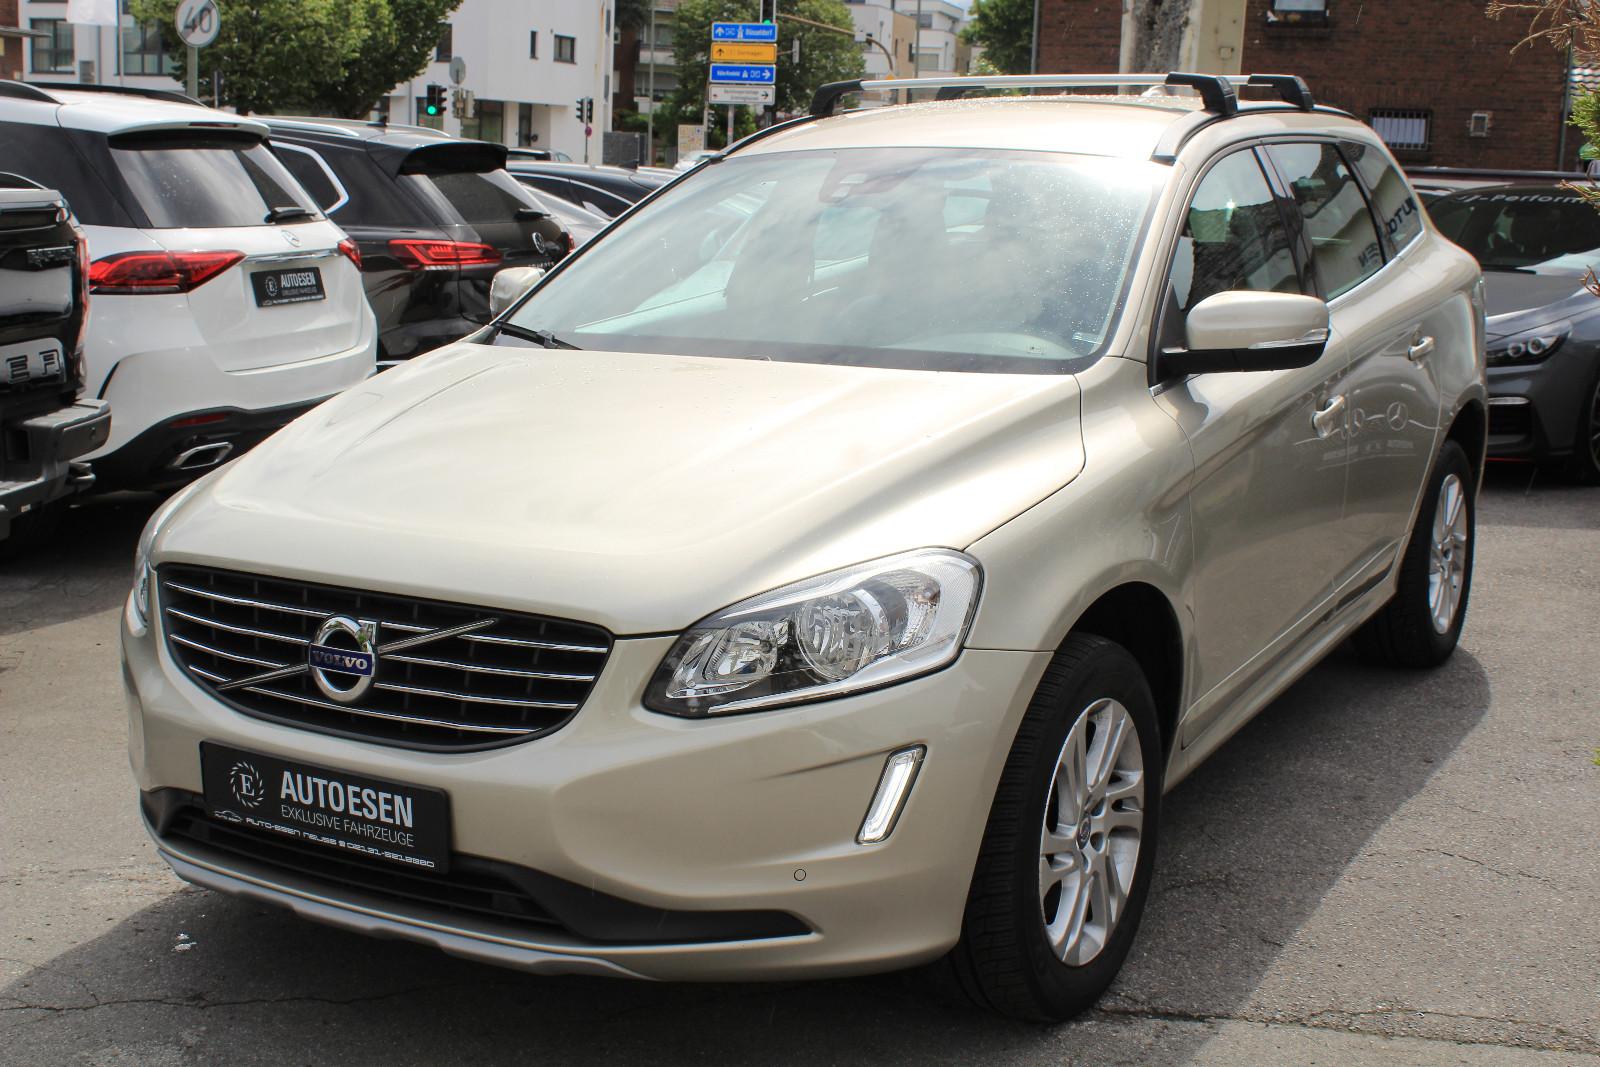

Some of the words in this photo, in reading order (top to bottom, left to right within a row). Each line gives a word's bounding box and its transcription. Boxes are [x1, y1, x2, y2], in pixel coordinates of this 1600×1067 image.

[183, 5, 212, 33] 40
[280, 272, 316, 288] AUTOESEN
[312, 650, 368, 670] VOLVO
[239, 773, 255, 797] E
[280, 770, 414, 828] AUTOESEN
[281, 804, 341, 831] EXKLUSIVE
[344, 819, 415, 848] FAHRZEUGE
